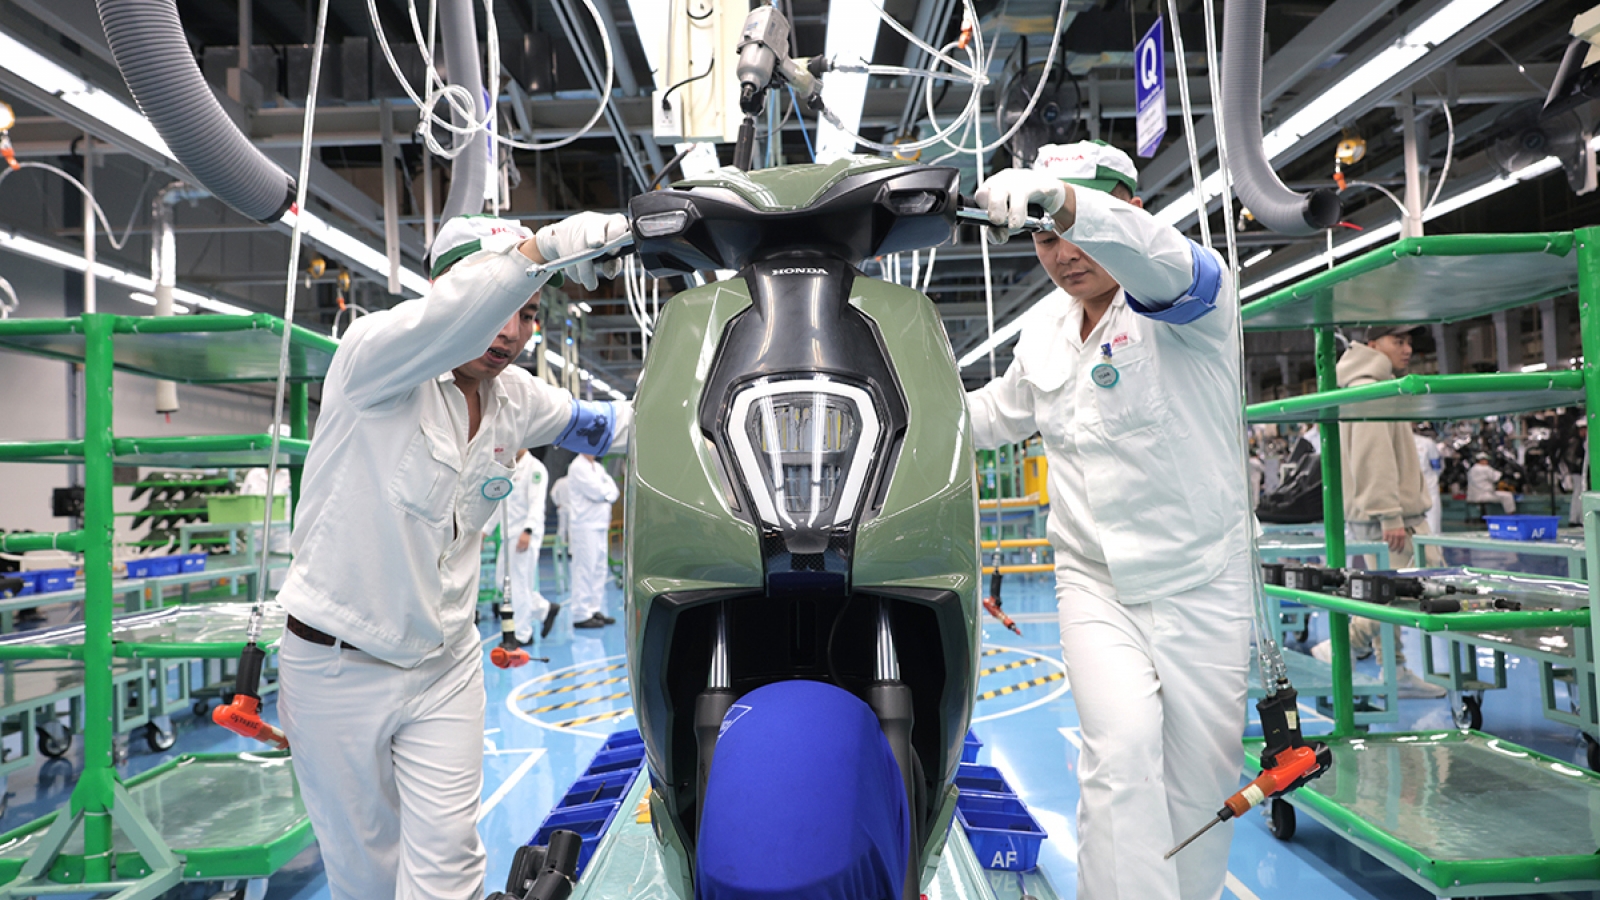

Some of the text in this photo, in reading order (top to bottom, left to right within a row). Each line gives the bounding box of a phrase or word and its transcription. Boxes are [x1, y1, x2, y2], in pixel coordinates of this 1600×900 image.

[1141, 37, 1158, 90] Q
[772, 267, 829, 276] HONDA
[1532, 527, 1546, 539] AF
[991, 850, 1018, 868] AF
